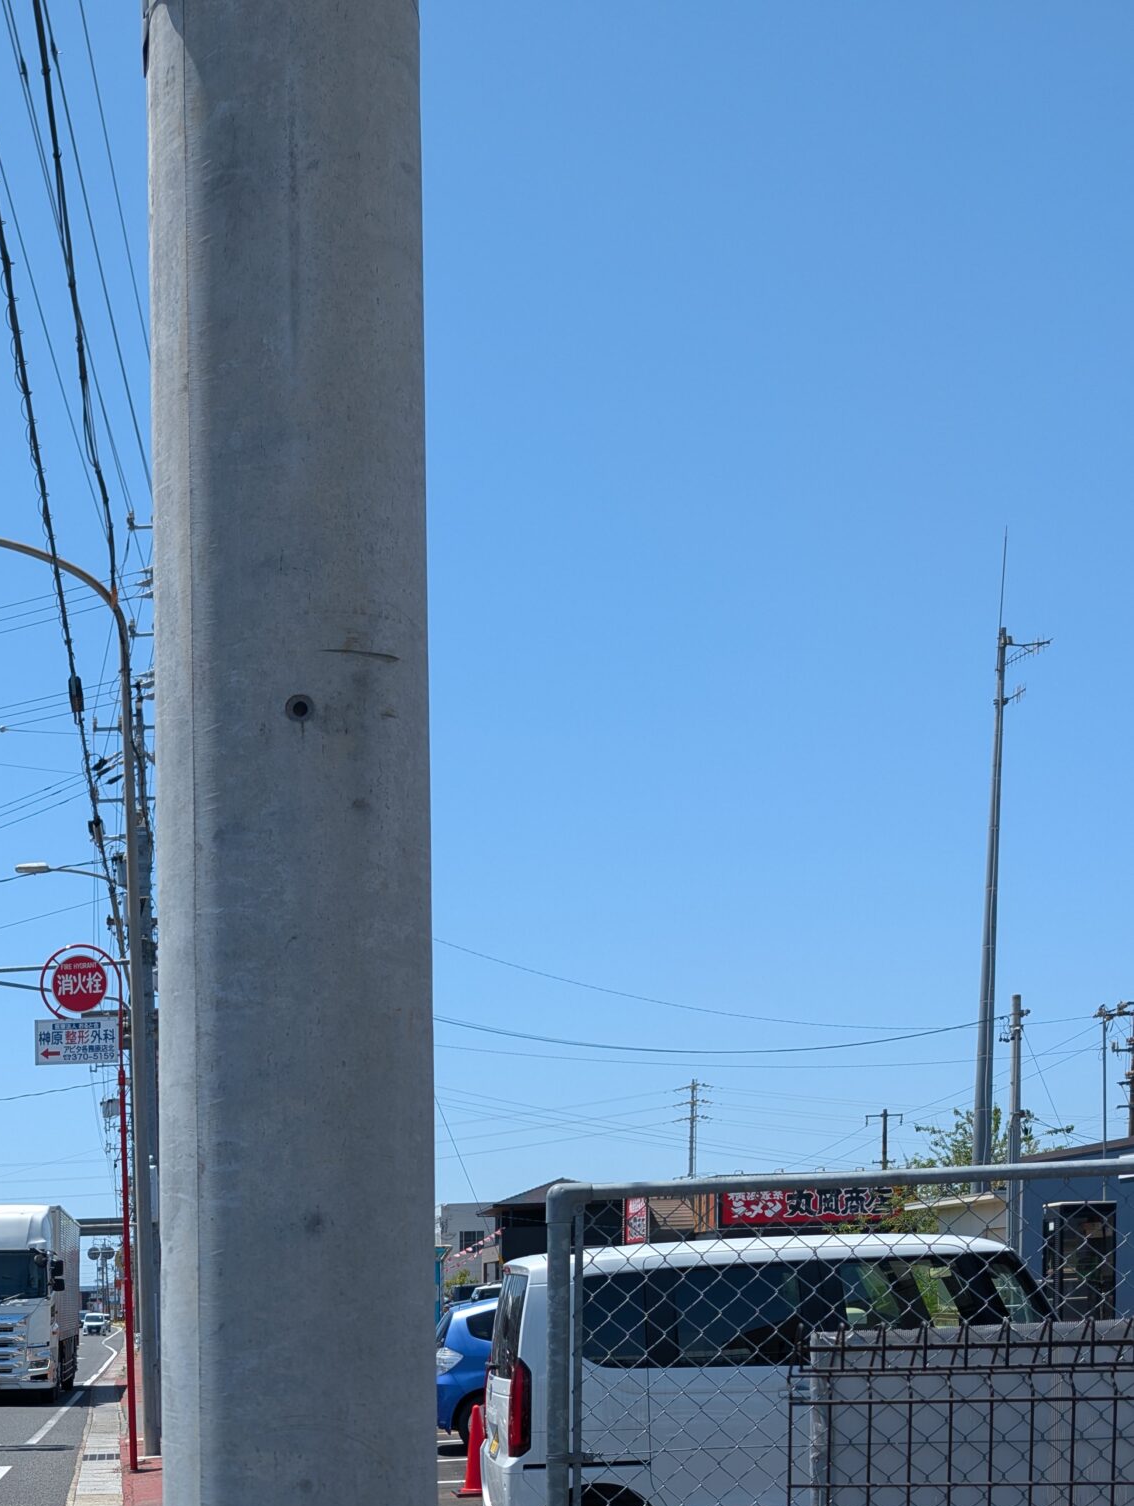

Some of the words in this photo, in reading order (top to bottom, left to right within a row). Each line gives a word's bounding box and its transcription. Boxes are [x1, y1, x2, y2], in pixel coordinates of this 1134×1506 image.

[57, 972, 103, 995] 消火栓
[38, 1028, 116, 1046] 榊原整形外科
[71, 1053, 115, 1061] 370-5159
